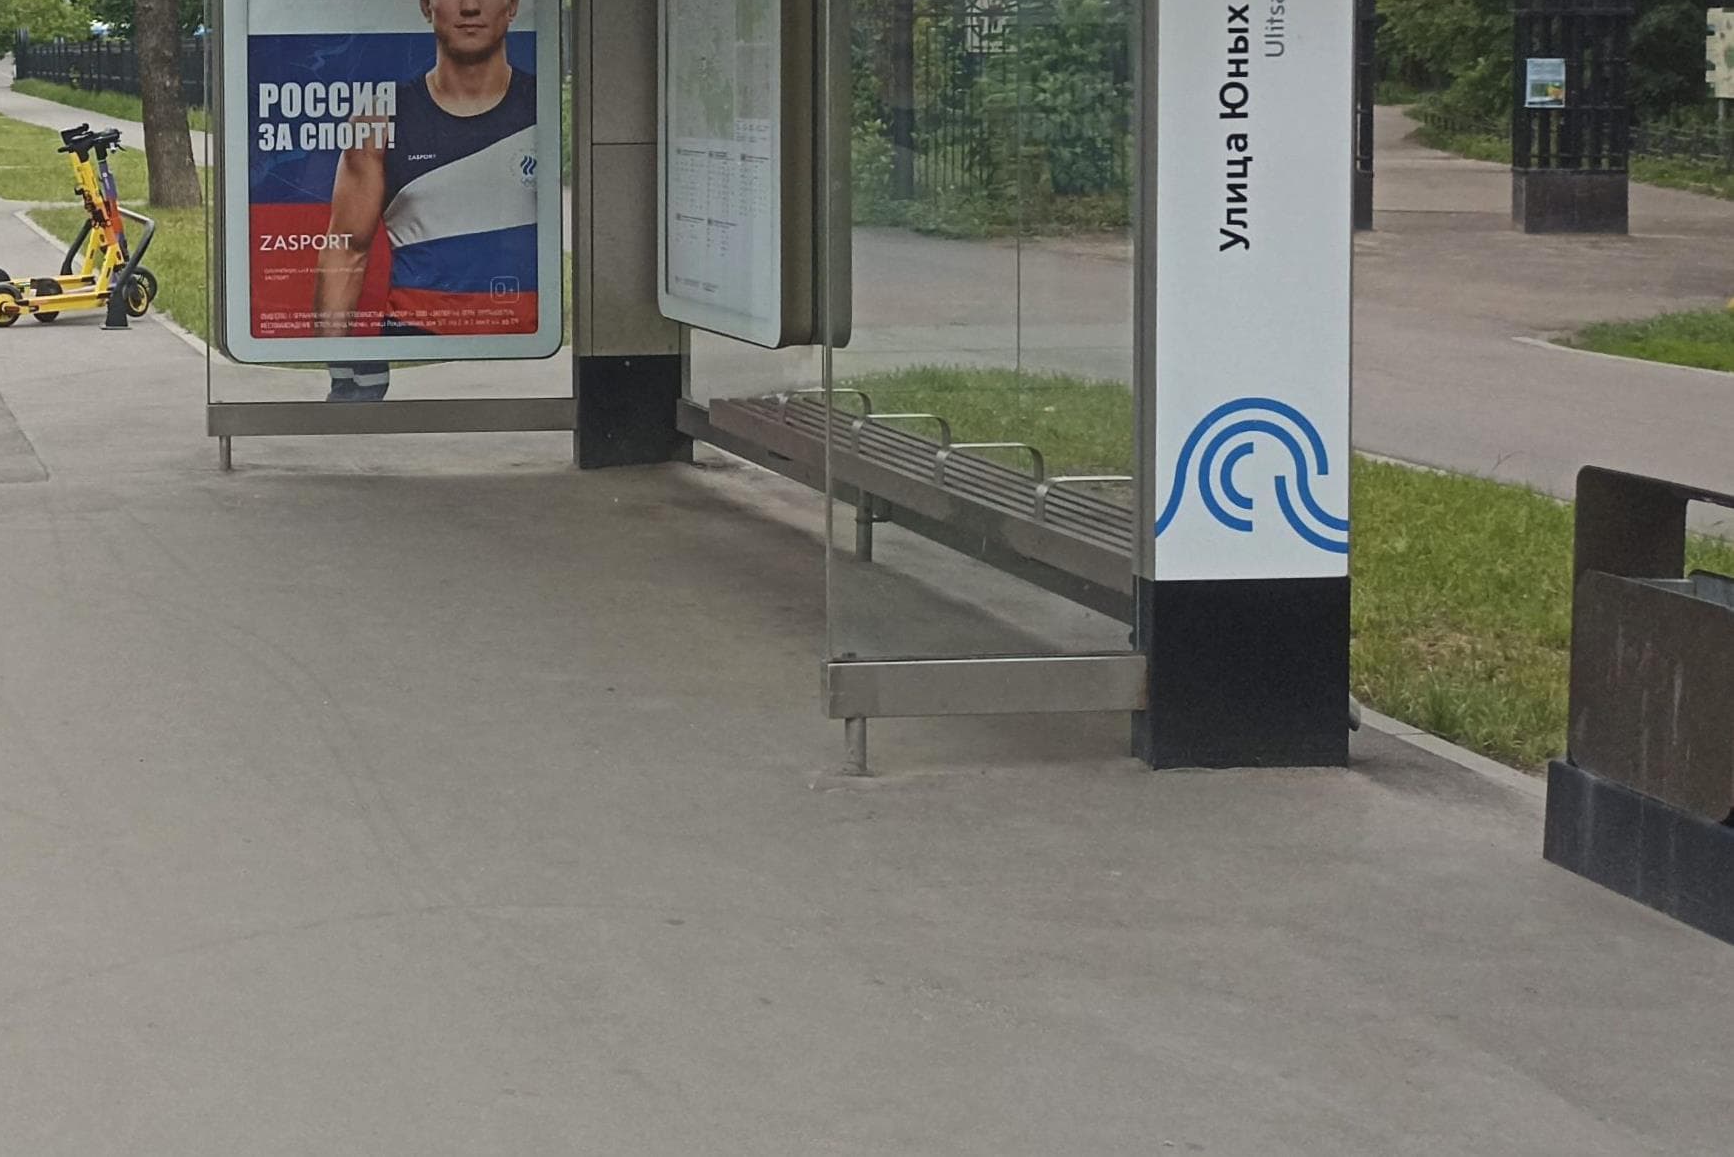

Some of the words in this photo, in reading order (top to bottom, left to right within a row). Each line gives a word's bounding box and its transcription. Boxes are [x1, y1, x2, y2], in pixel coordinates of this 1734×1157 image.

[1218, 2, 1250, 120] Юных
[259, 81, 397, 119] РОССИЯ
[258, 123, 293, 151] ЗА
[299, 121, 395, 151] СПОРТ!
[1219, 132, 1254, 252] Улица
[260, 233, 353, 251] ZASPORT
[494, 282, 515, 298] 0+
